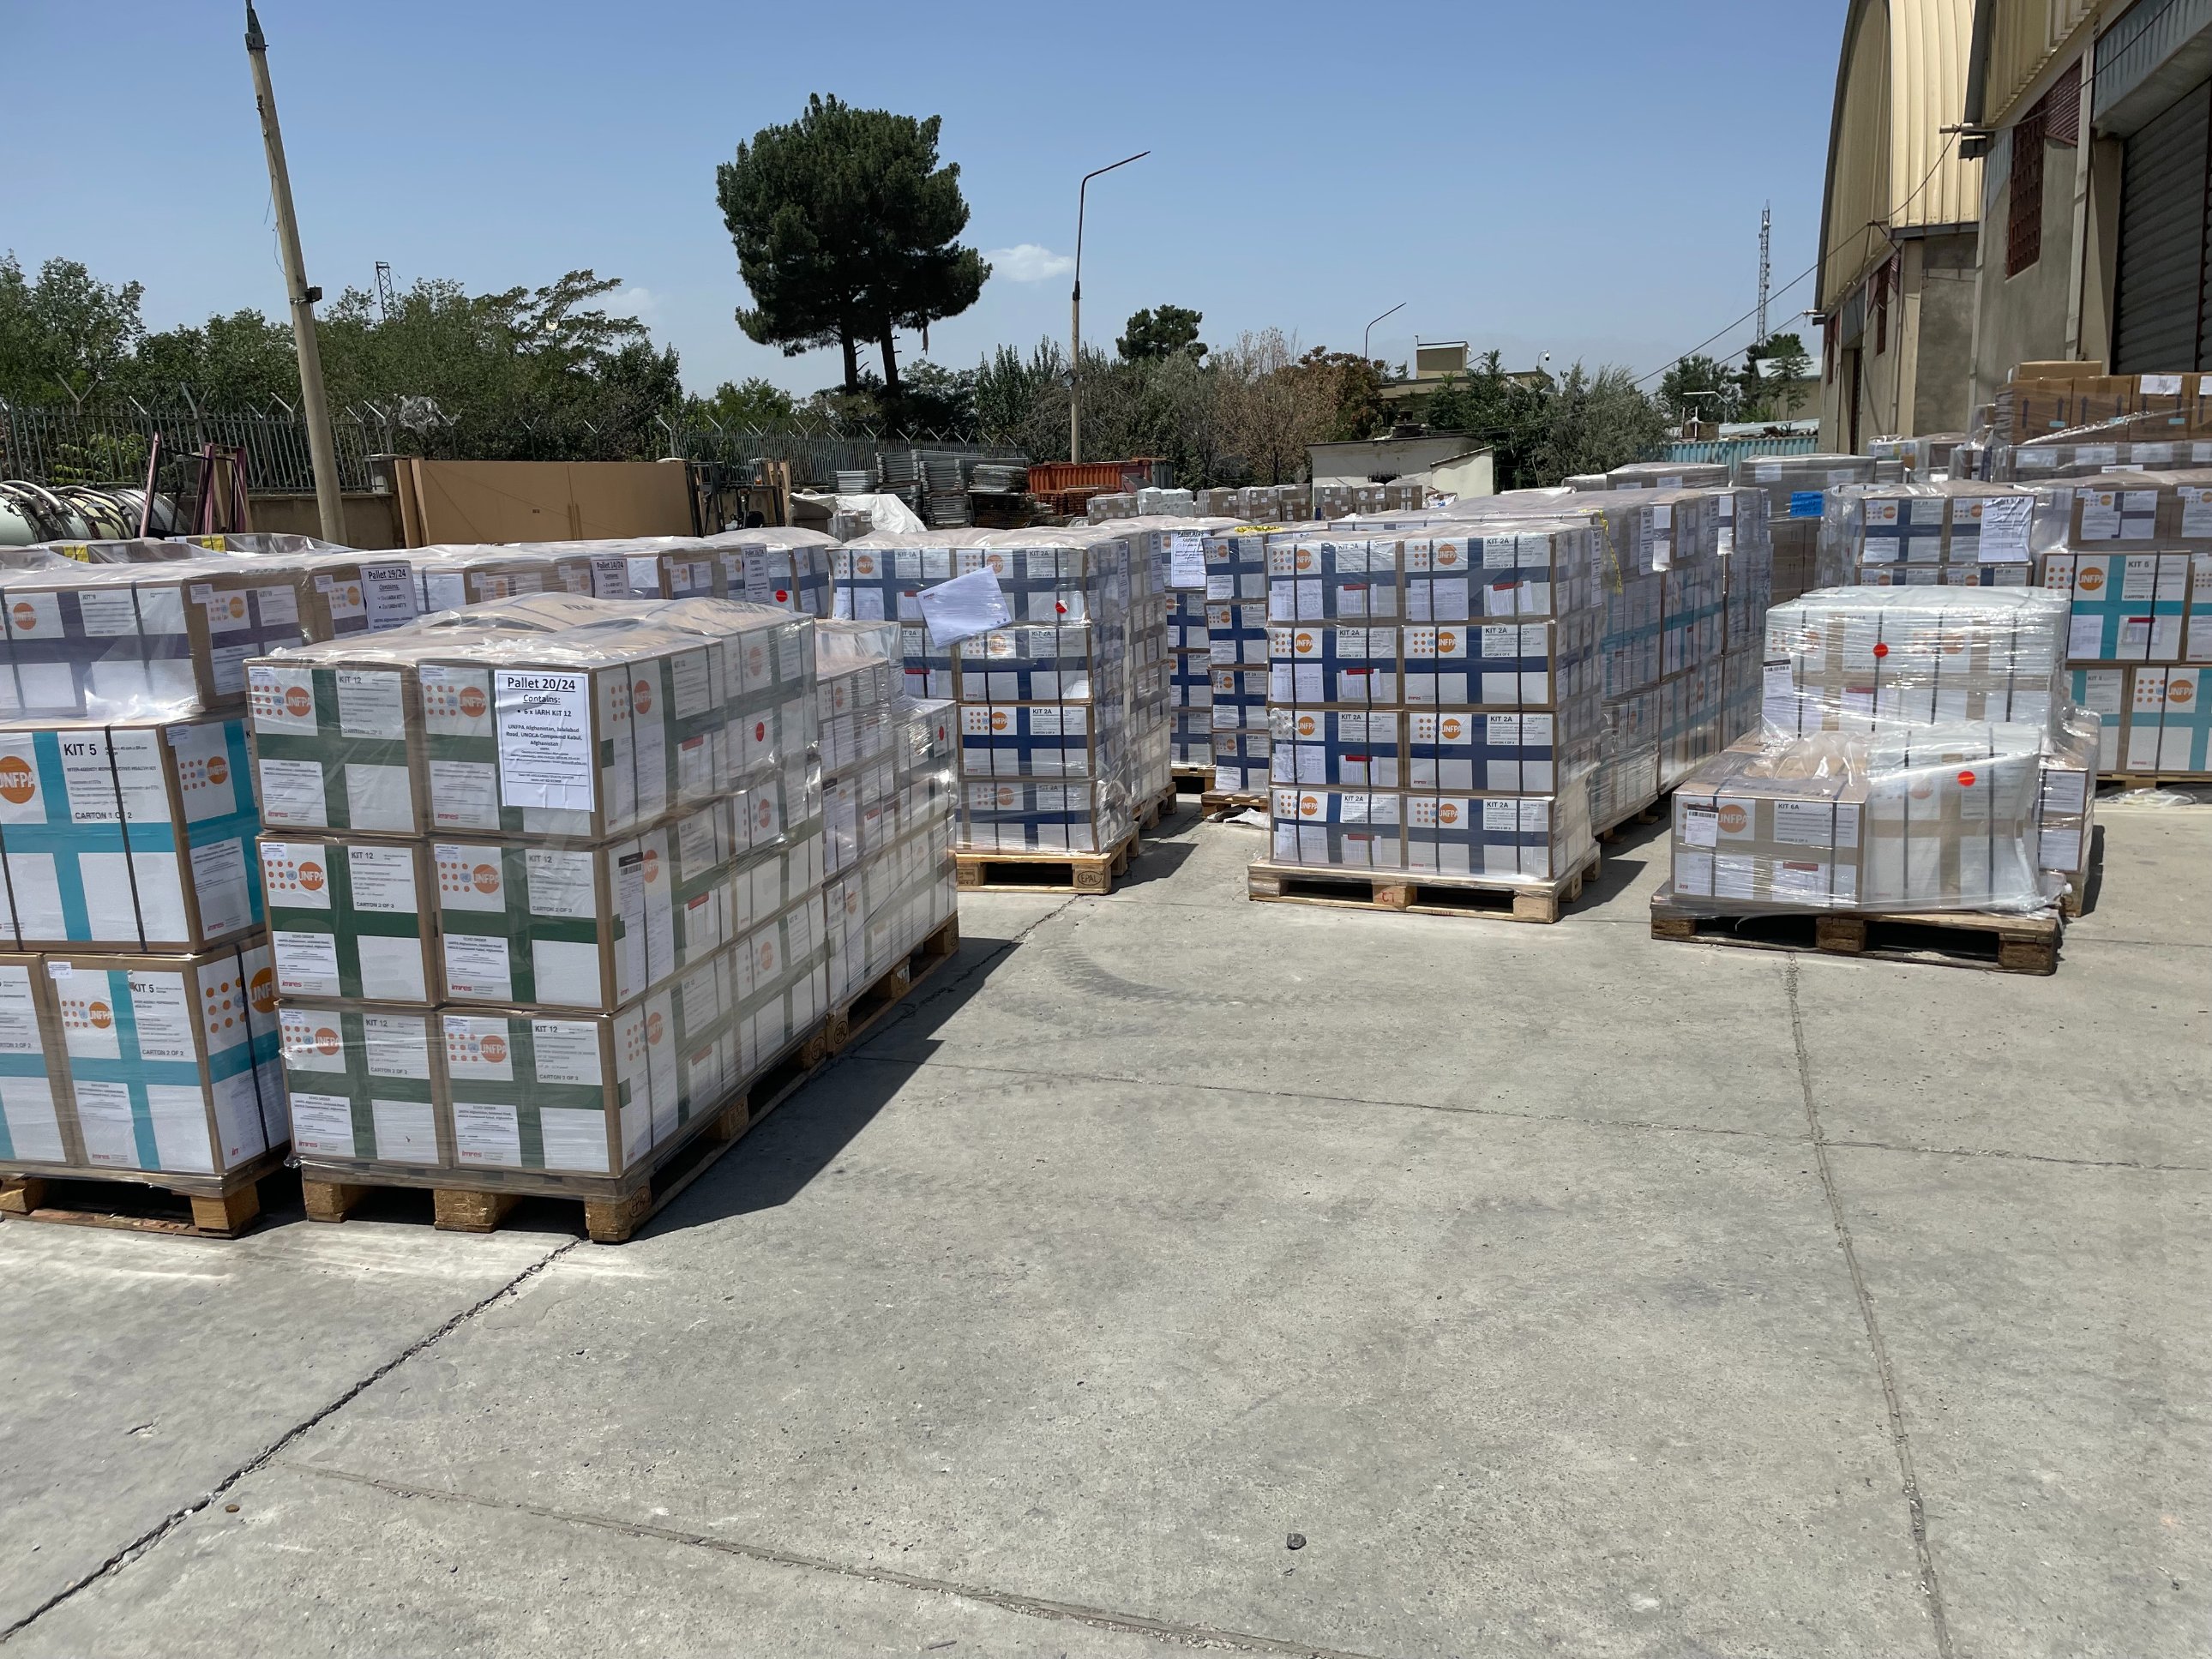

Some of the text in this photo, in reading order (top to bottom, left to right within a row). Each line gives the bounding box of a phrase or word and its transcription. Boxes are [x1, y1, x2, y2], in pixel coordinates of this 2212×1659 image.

[368, 570, 387, 580] Pallet
[339, 676, 363, 685] KIT 12
[508, 677, 575, 692] Pallet 20/24
[523, 694, 562, 704] Contains:
[64, 743, 85, 756] KIT
[89, 743, 97, 755] 5
[364, 851, 374, 860] 12
[544, 855, 552, 863] 12
[299, 869, 324, 882] UNFPA
[472, 872, 500, 885] UNFPA
[1080, 873, 1098, 883] EPAL
[133, 983, 155, 993] KIT 5
[281, 979, 303, 988] imres
[451, 983, 472, 992] imres
[250, 982, 272, 1000] UNF
[89, 1010, 112, 1020] UNFPA
[534, 1025, 547, 1033] KIT
[481, 1043, 508, 1055] UNFPA
[461, 1150, 483, 1158] imres
